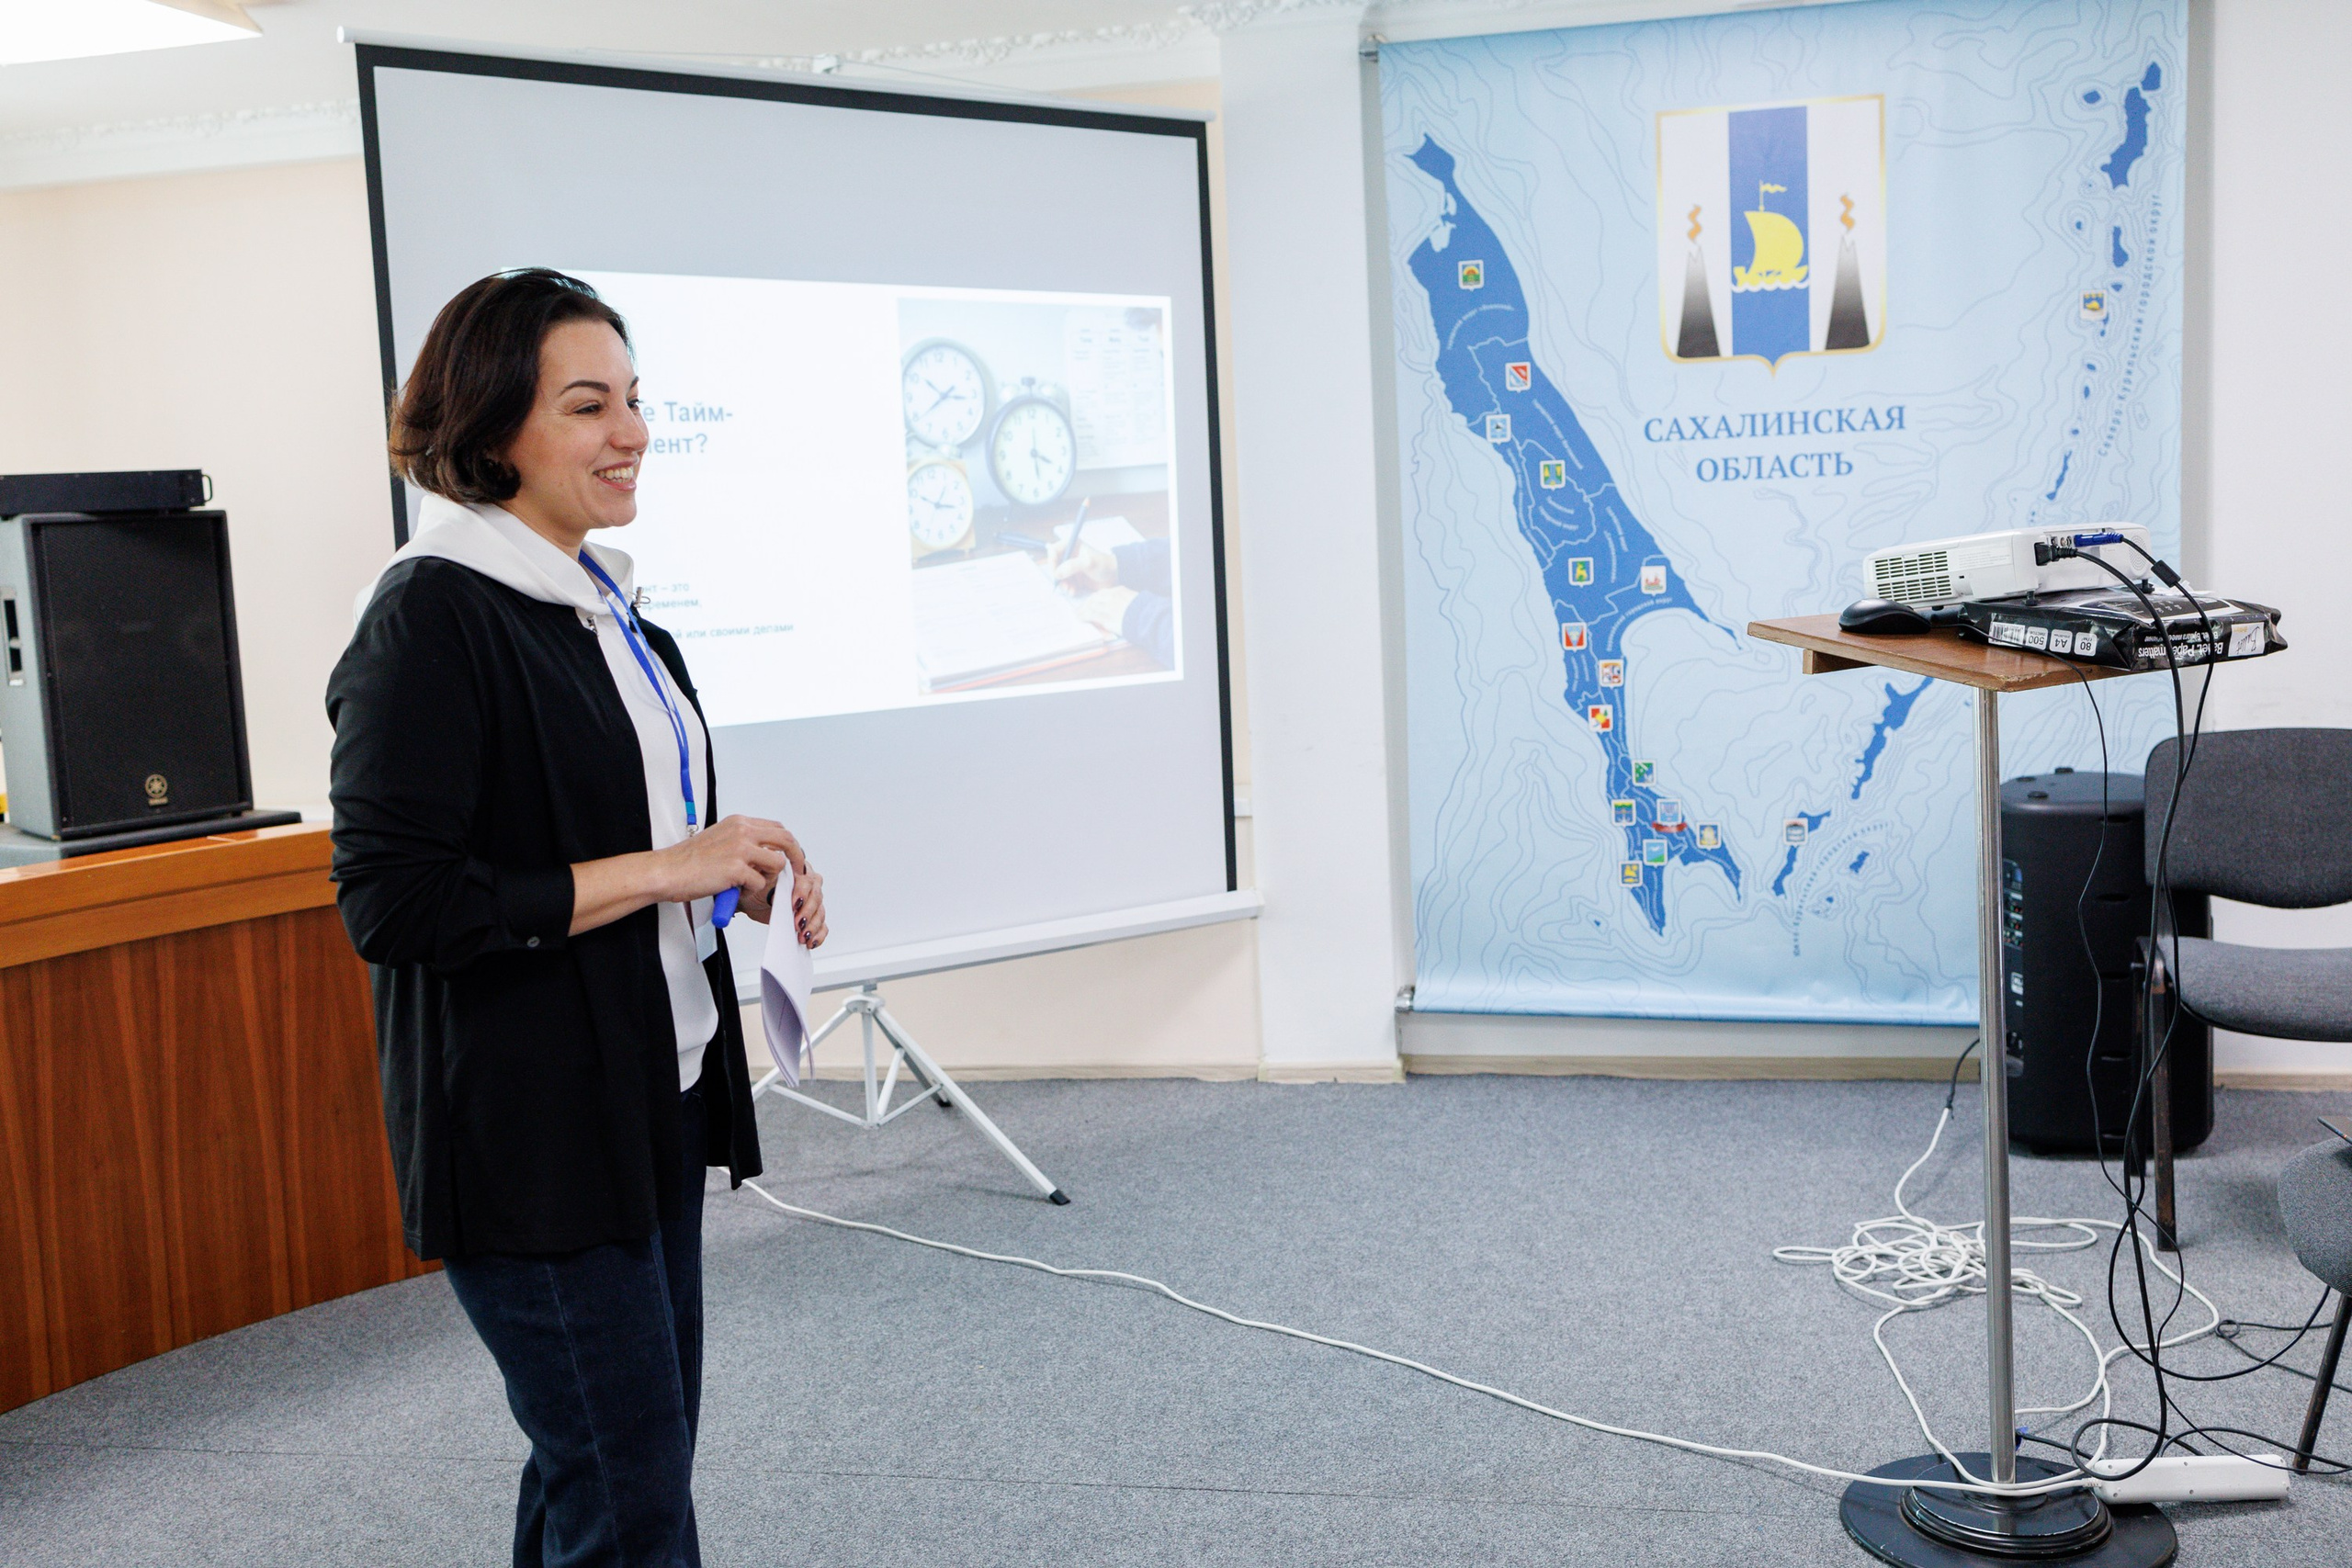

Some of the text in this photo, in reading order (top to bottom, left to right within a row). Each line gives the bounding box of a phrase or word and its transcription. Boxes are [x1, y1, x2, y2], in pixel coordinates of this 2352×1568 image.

[663, 400, 733, 422] Тайм-
[1644, 405, 1906, 443] САХАЛИНСКАЯ
[1696, 452, 1854, 482] ОБЛАСТЬ
[686, 630, 707, 638] или
[709, 627, 750, 637] своими
[2028, 635, 2045, 646] 500
[2080, 641, 2092, 651] 80
[2138, 646, 2166, 659] matters
[2172, 642, 2195, 657] Pape
